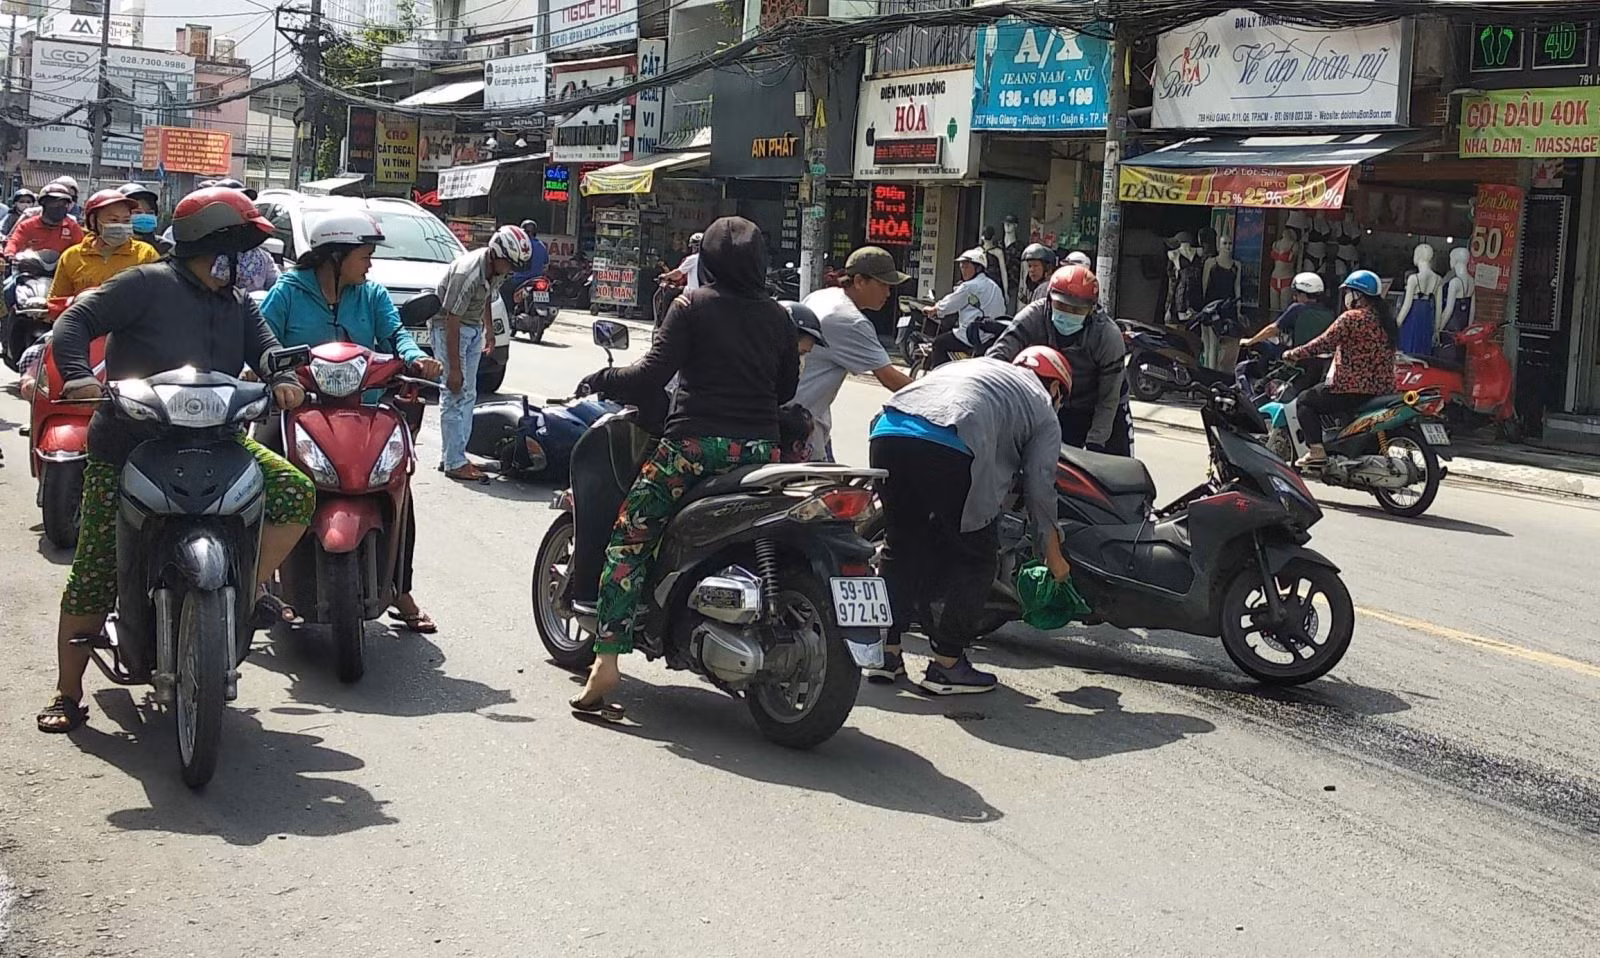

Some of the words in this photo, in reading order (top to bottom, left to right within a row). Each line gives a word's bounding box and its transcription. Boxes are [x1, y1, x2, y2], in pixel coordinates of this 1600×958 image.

[1014, 27, 1084, 69] A/X
[1544, 22, 1577, 60] 4D
[120, 55, 186, 69] 028.7300.9986
[641, 46, 661, 76] CẮT
[1301, 35, 1348, 81] hoàn
[1000, 72, 1036, 85] JEANS
[1039, 71, 1066, 84] NAM
[1075, 66, 1095, 81] NỮ
[1579, 74, 1593, 86] 791
[880, 84, 897, 101] ĐIỆN
[898, 82, 918, 98] THOẠI
[919, 83, 925, 95] DI
[926, 80, 946, 99] ĐỘNG
[999, 90, 1022, 107] 135
[1033, 89, 1056, 106] 165
[894, 96, 927, 132] HÒA
[1504, 91, 1544, 127] ĐẦU
[1550, 100, 1589, 126] 40K
[642, 111, 655, 127] VI
[986, 114, 998, 127] Hậu
[999, 114, 1017, 127] Giang
[1048, 114, 1055, 124] 11
[1061, 113, 1078, 126] Quận
[1079, 113, 1084, 123] 6
[1090, 112, 1100, 123] TP.
[393, 145, 416, 155] DECAL
[637, 133, 657, 154] TÍNH
[751, 138, 766, 158] AN
[1535, 136, 1598, 153] MASSAGE
[382, 158, 390, 167] VI
[393, 156, 411, 168] TÍNH
[385, 171, 391, 179] VI
[394, 171, 410, 180] TINH
[1260, 168, 1284, 177] Sale
[1212, 190, 1242, 204] 15%
[1243, 187, 1283, 205] 25%
[1283, 173, 1341, 207] 50%
[1260, 180, 1270, 188] UP
[1275, 180, 1286, 188] TO
[869, 215, 911, 237] HÒA
[1081, 216, 1097, 235] 135
[549, 239, 575, 255] ÁN
[839, 602, 888, 623] 972.49
